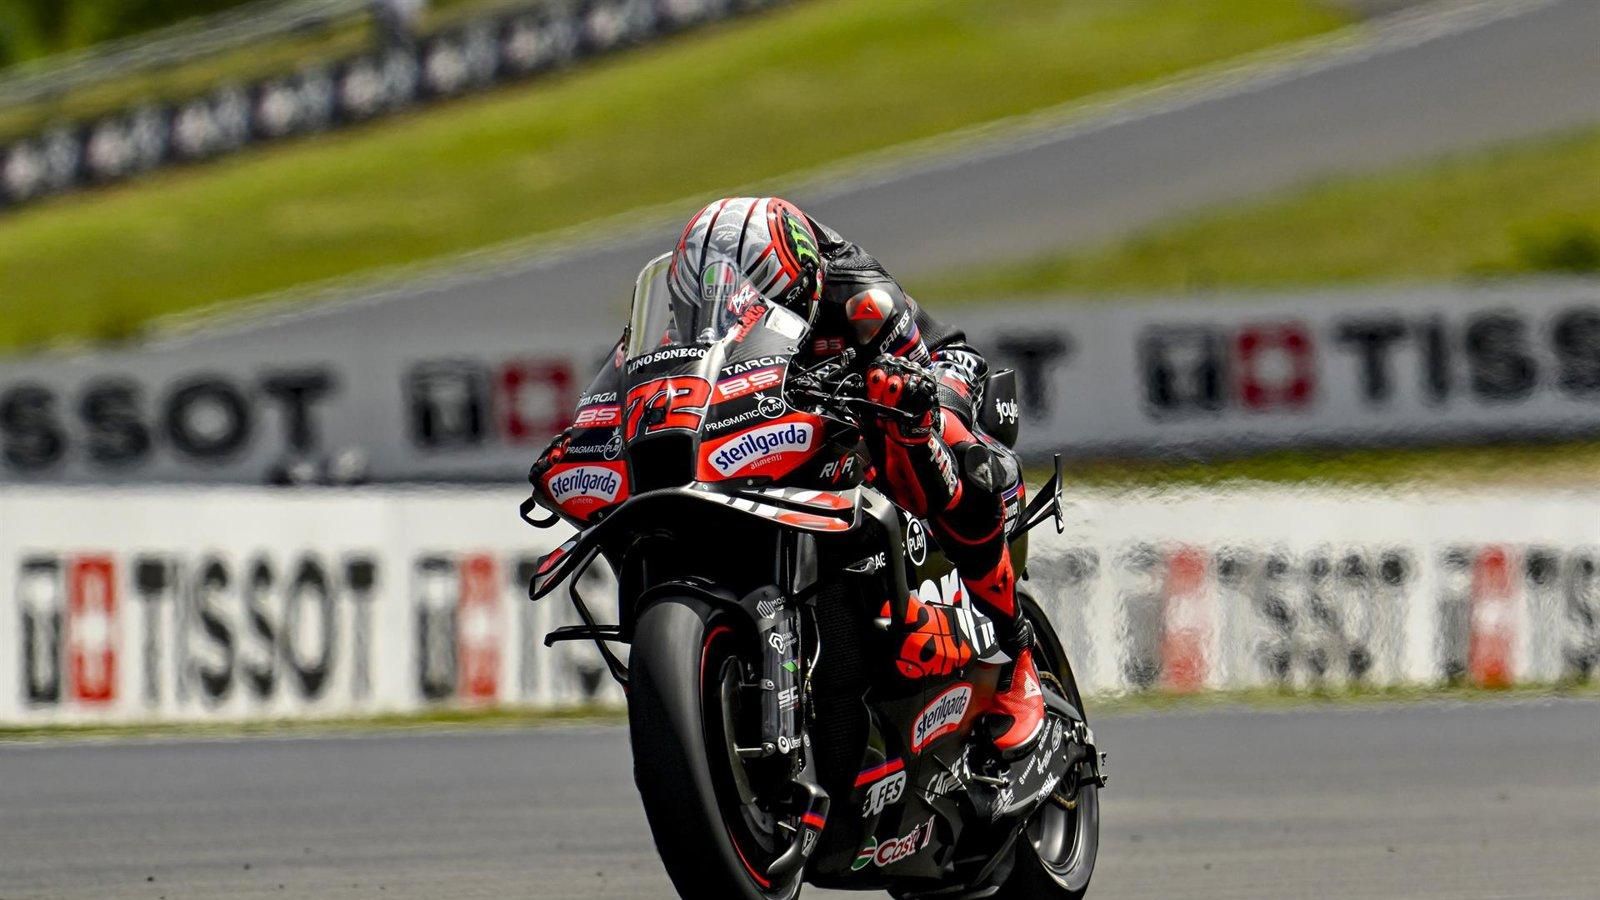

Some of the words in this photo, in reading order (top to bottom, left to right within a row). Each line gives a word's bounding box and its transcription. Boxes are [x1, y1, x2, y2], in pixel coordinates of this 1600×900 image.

[627, 355, 653, 374] LINO
[653, 348, 707, 361] SONEGO
[722, 356, 788, 376] TARGA
[718, 369, 779, 396] BS
[579, 391, 617, 408] TARGA
[624, 375, 714, 443] 72
[575, 407, 619, 424] BS
[705, 409, 760, 432] PRAGMATIC
[761, 402, 783, 414] PLAY
[565, 445, 604, 454] PRAGMATIC
[715, 424, 807, 471] sterilgarda
[551, 468, 617, 498] sterilgarda
[134, 553, 376, 702] TISSOT
[916, 689, 967, 738] sterilgarda
